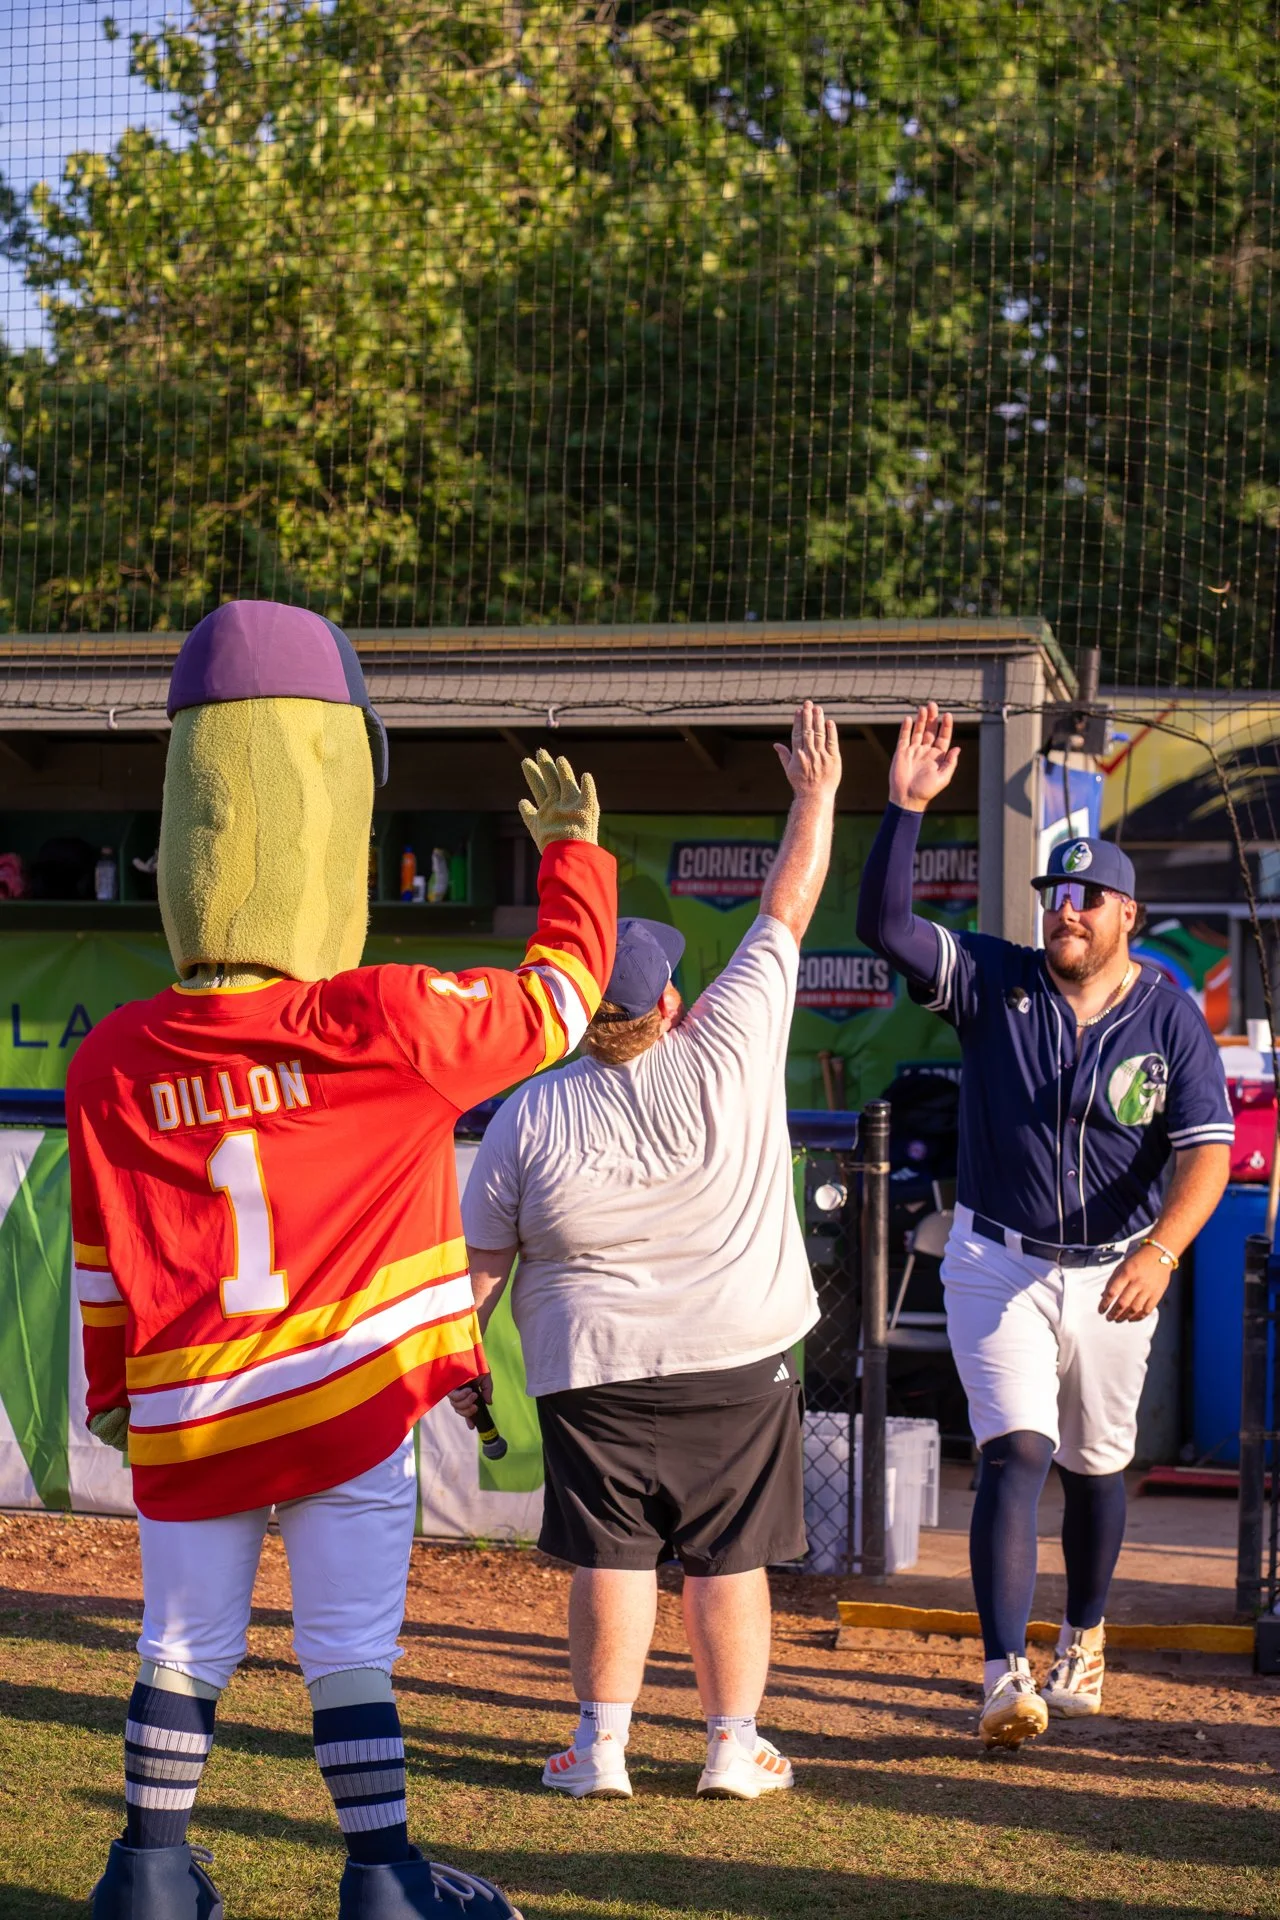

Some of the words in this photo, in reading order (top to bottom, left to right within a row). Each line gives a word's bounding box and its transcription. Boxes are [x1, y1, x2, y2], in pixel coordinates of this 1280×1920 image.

[12, 1003, 125, 1048] LA
[151, 1060, 311, 1131] DILLON
[206, 1129, 289, 1319] 1
